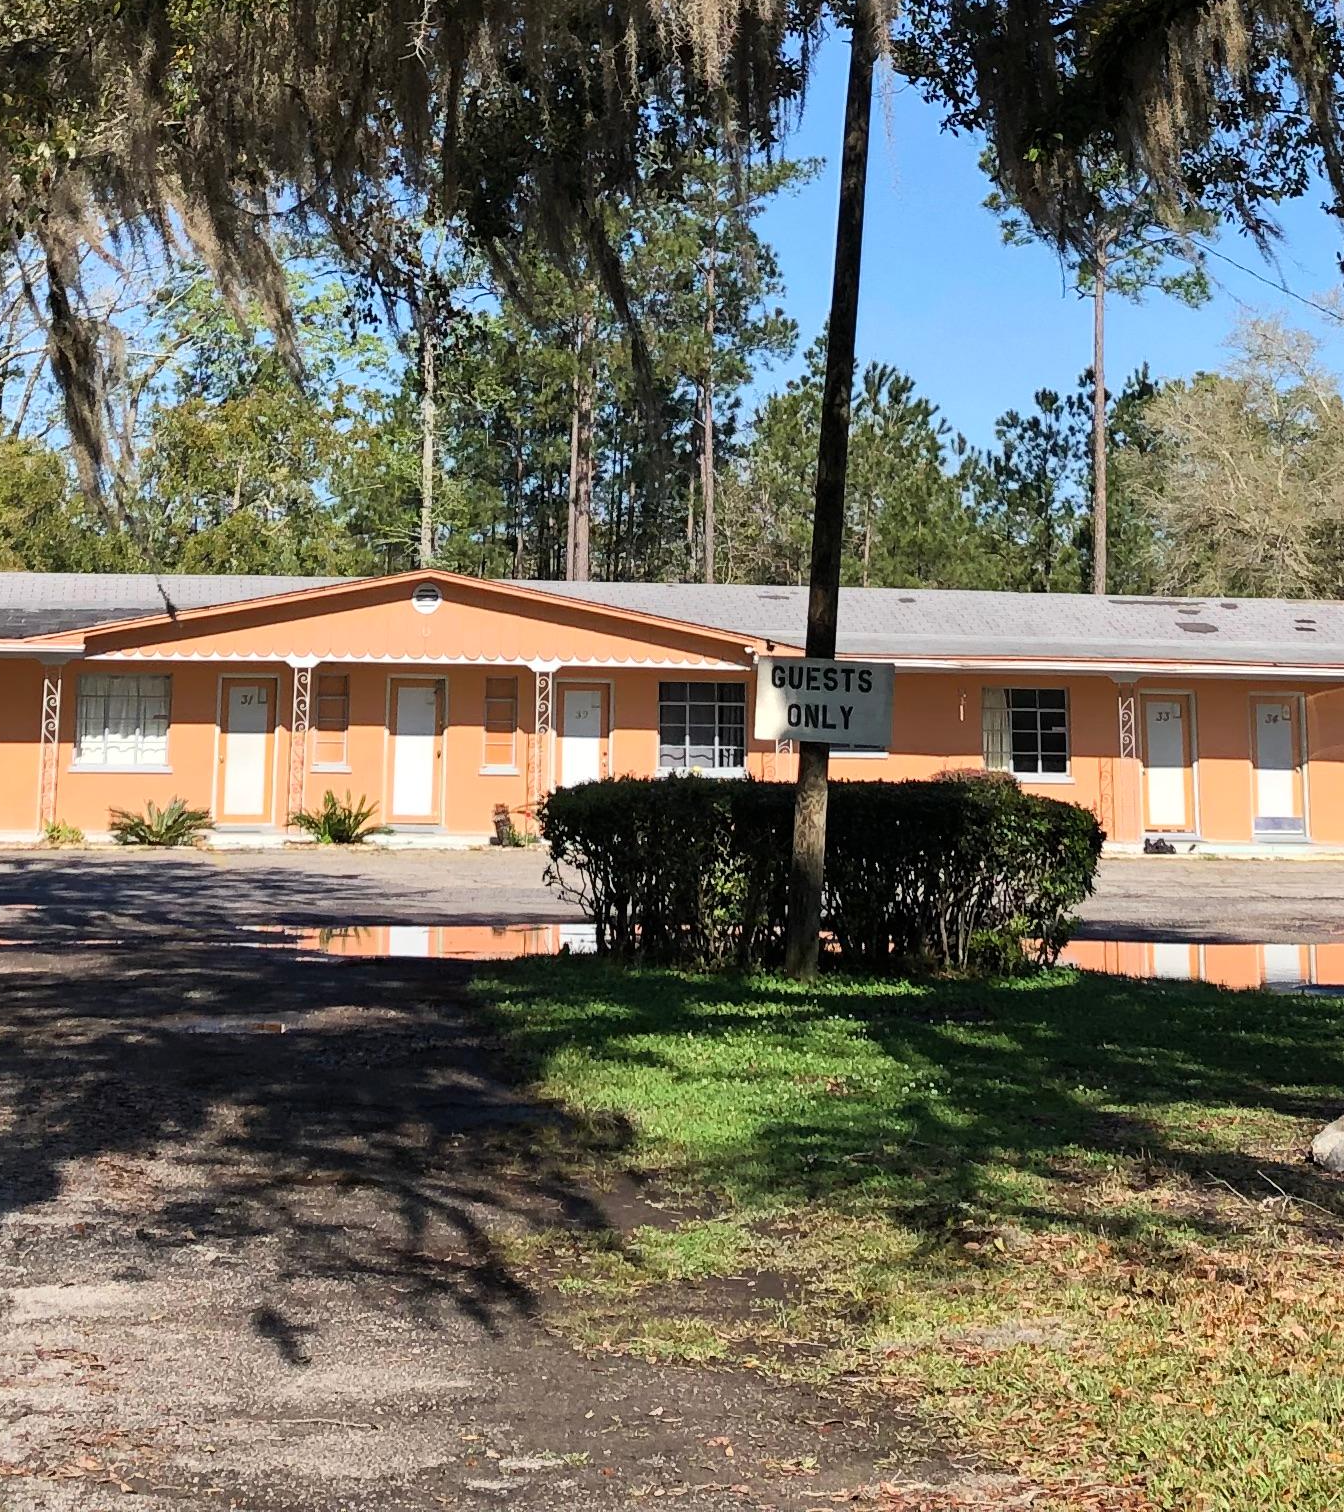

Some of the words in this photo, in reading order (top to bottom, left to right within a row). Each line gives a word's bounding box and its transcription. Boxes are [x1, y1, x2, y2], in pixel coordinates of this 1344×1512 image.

[771, 665, 873, 693] GUESTS
[787, 703, 854, 730] ONLY
[1156, 711, 1170, 721] 33
